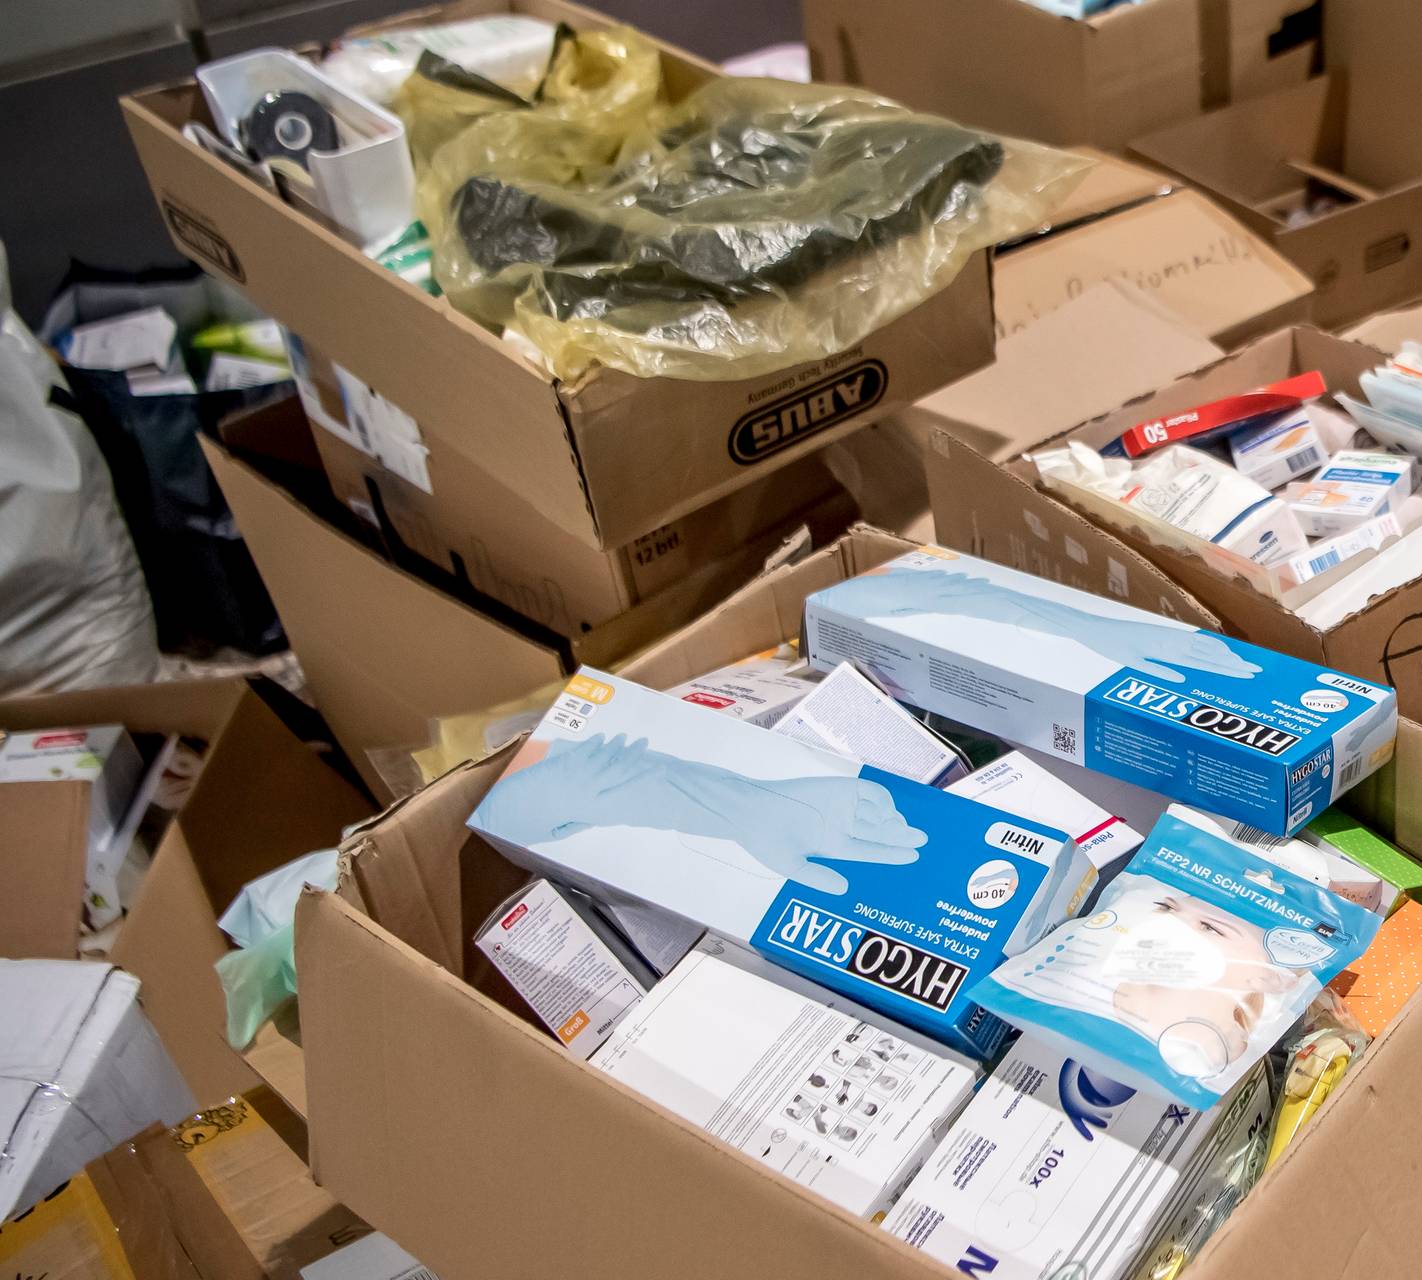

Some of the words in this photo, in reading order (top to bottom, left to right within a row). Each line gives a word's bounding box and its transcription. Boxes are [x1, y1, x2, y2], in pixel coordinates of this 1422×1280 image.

[824, 345, 863, 370] Security
[797, 366, 822, 383] Tech
[748, 377, 796, 404] Germany
[752, 374, 865, 450] ABUS
[1143, 422, 1168, 443] 50
[1331, 677, 1372, 695] Nitril
[1190, 687, 1249, 714] SUPERLONG
[1271, 699, 1329, 723] powderfree
[1305, 700, 1320, 708] cm
[569, 718, 582, 730] 50
[1249, 706, 1278, 724] SAFE
[1272, 708, 1323, 727] puderfrei
[1279, 717, 1312, 735] EXTRA
[1291, 748, 1331, 785] HYGOSTAR
[1000, 830, 1045, 856] Nitril
[973, 891, 987, 902] cm
[989, 887, 1006, 900] 40
[1157, 846, 1191, 870] FFP2
[1191, 861, 1214, 881] NR
[1211, 872, 1315, 929] SCHUTZMASKE
[854, 903, 916, 934] SUPERLONG
[936, 900, 998, 929] powderfree
[915, 925, 945, 946] SAFE
[939, 917, 991, 942] puderfrei
[949, 938, 980, 960] EXTRA
[564, 1015, 585, 1036] Groß
[596, 1018, 613, 1036] Mittel
[1014, 1065, 1034, 1092] gloves
[1027, 1071, 1048, 1096] Latex
[1002, 1068, 1041, 1120] examination
[1029, 1148, 1066, 1189] 100x
